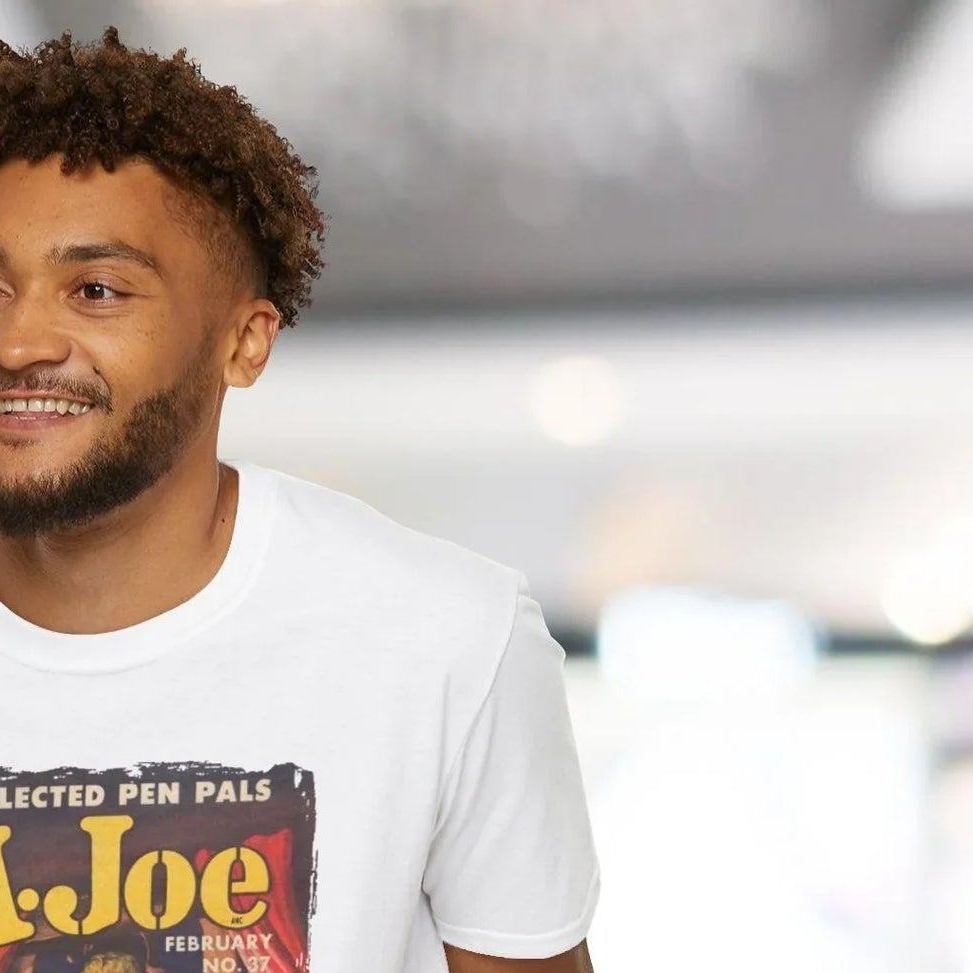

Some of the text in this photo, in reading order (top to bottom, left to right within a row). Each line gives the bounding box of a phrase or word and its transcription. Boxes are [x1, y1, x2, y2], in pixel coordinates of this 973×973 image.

[119, 782, 180, 805] PEN
[195, 778, 272, 803] PALS
[165, 933, 273, 952] FEBRUARY
[202, 955, 270, 973] NO. 37
